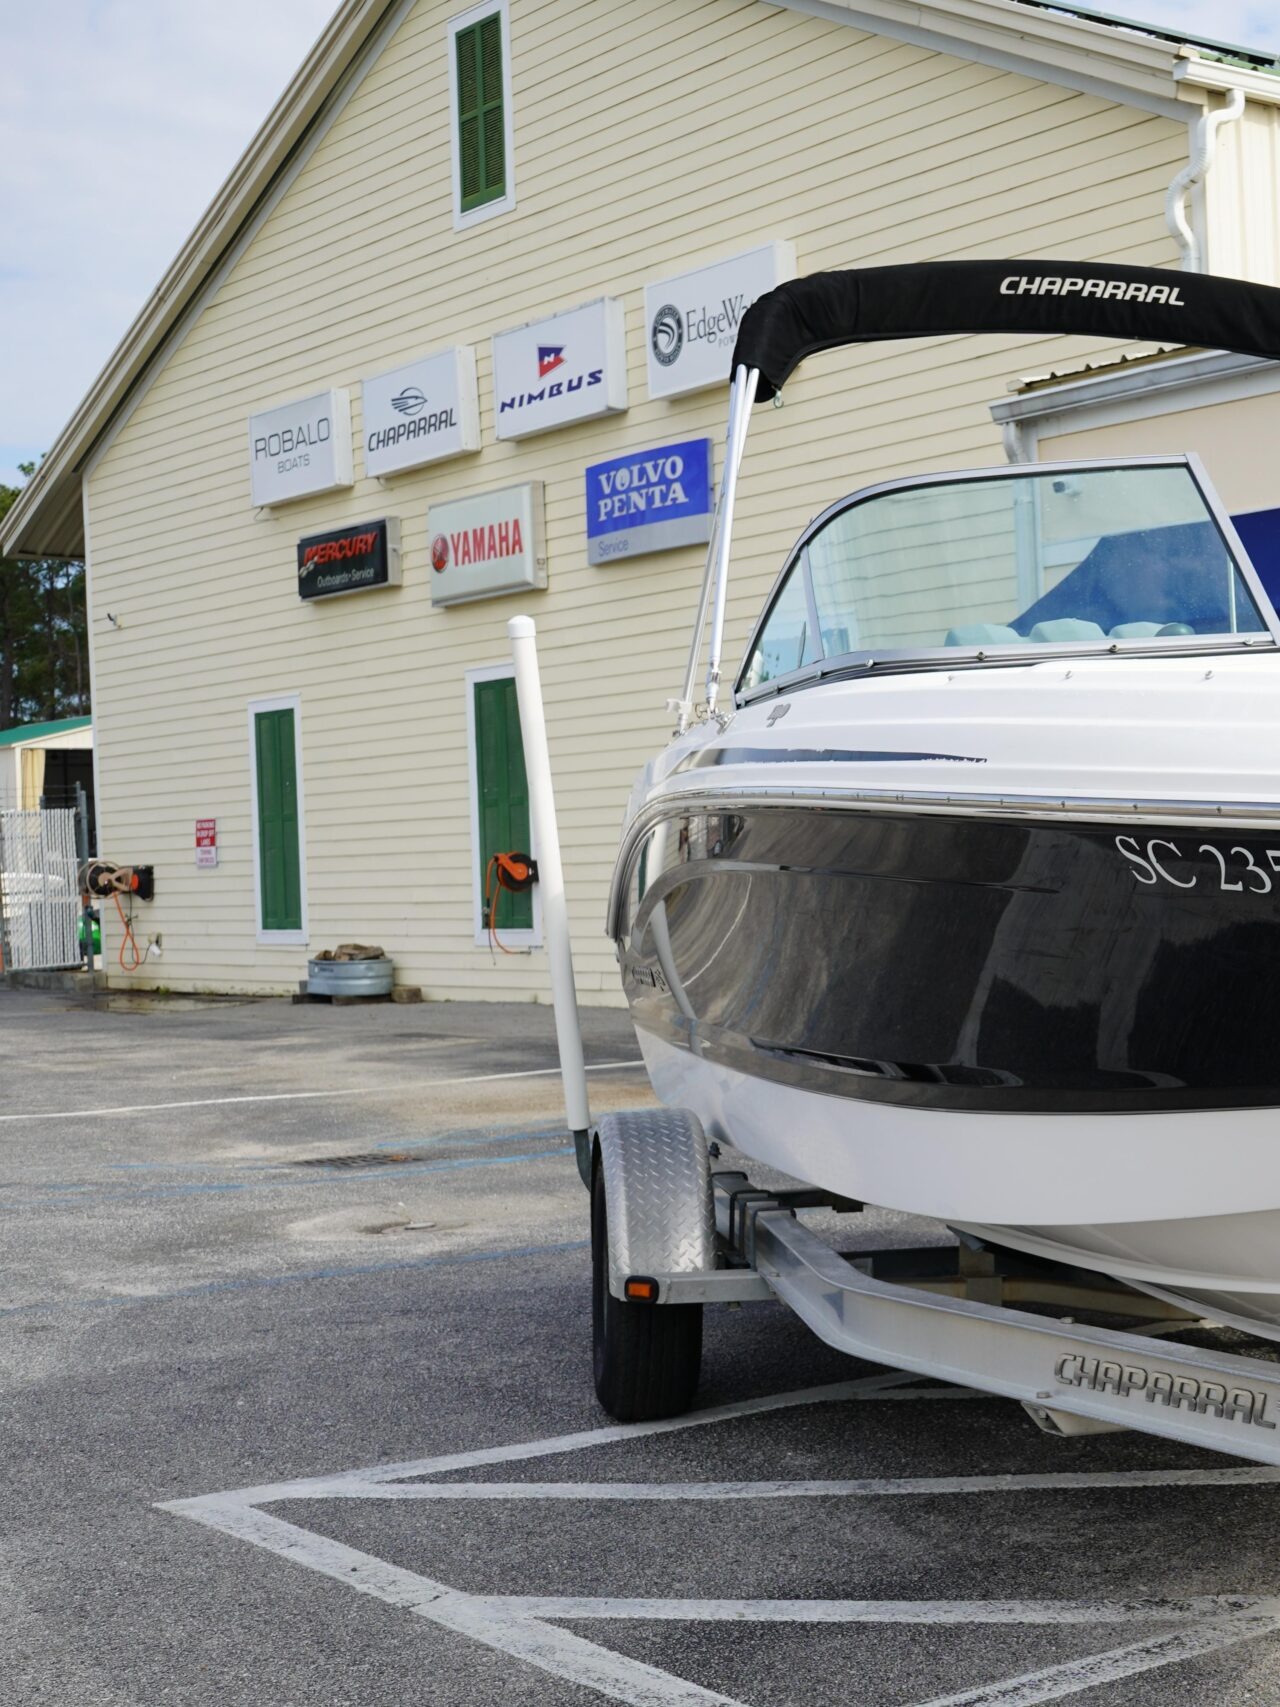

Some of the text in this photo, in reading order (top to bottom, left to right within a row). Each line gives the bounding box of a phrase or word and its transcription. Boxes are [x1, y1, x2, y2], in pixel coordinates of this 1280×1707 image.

[1000, 276, 1185, 306] CHAPARRAL
[500, 369, 603, 413] NIMBUS
[255, 417, 330, 461] ROBALO
[368, 408, 457, 452] CHAPARRAL
[278, 453, 310, 474] BOATS
[598, 455, 684, 495] VOLVO
[598, 481, 689, 522] PENTA
[304, 531, 378, 567] MERCURY
[451, 518, 523, 567] YAMAHA
[598, 538, 629, 557] Service
[1115, 835, 1197, 888] SC
[1054, 1352, 1276, 1429] CHAPARRAL
